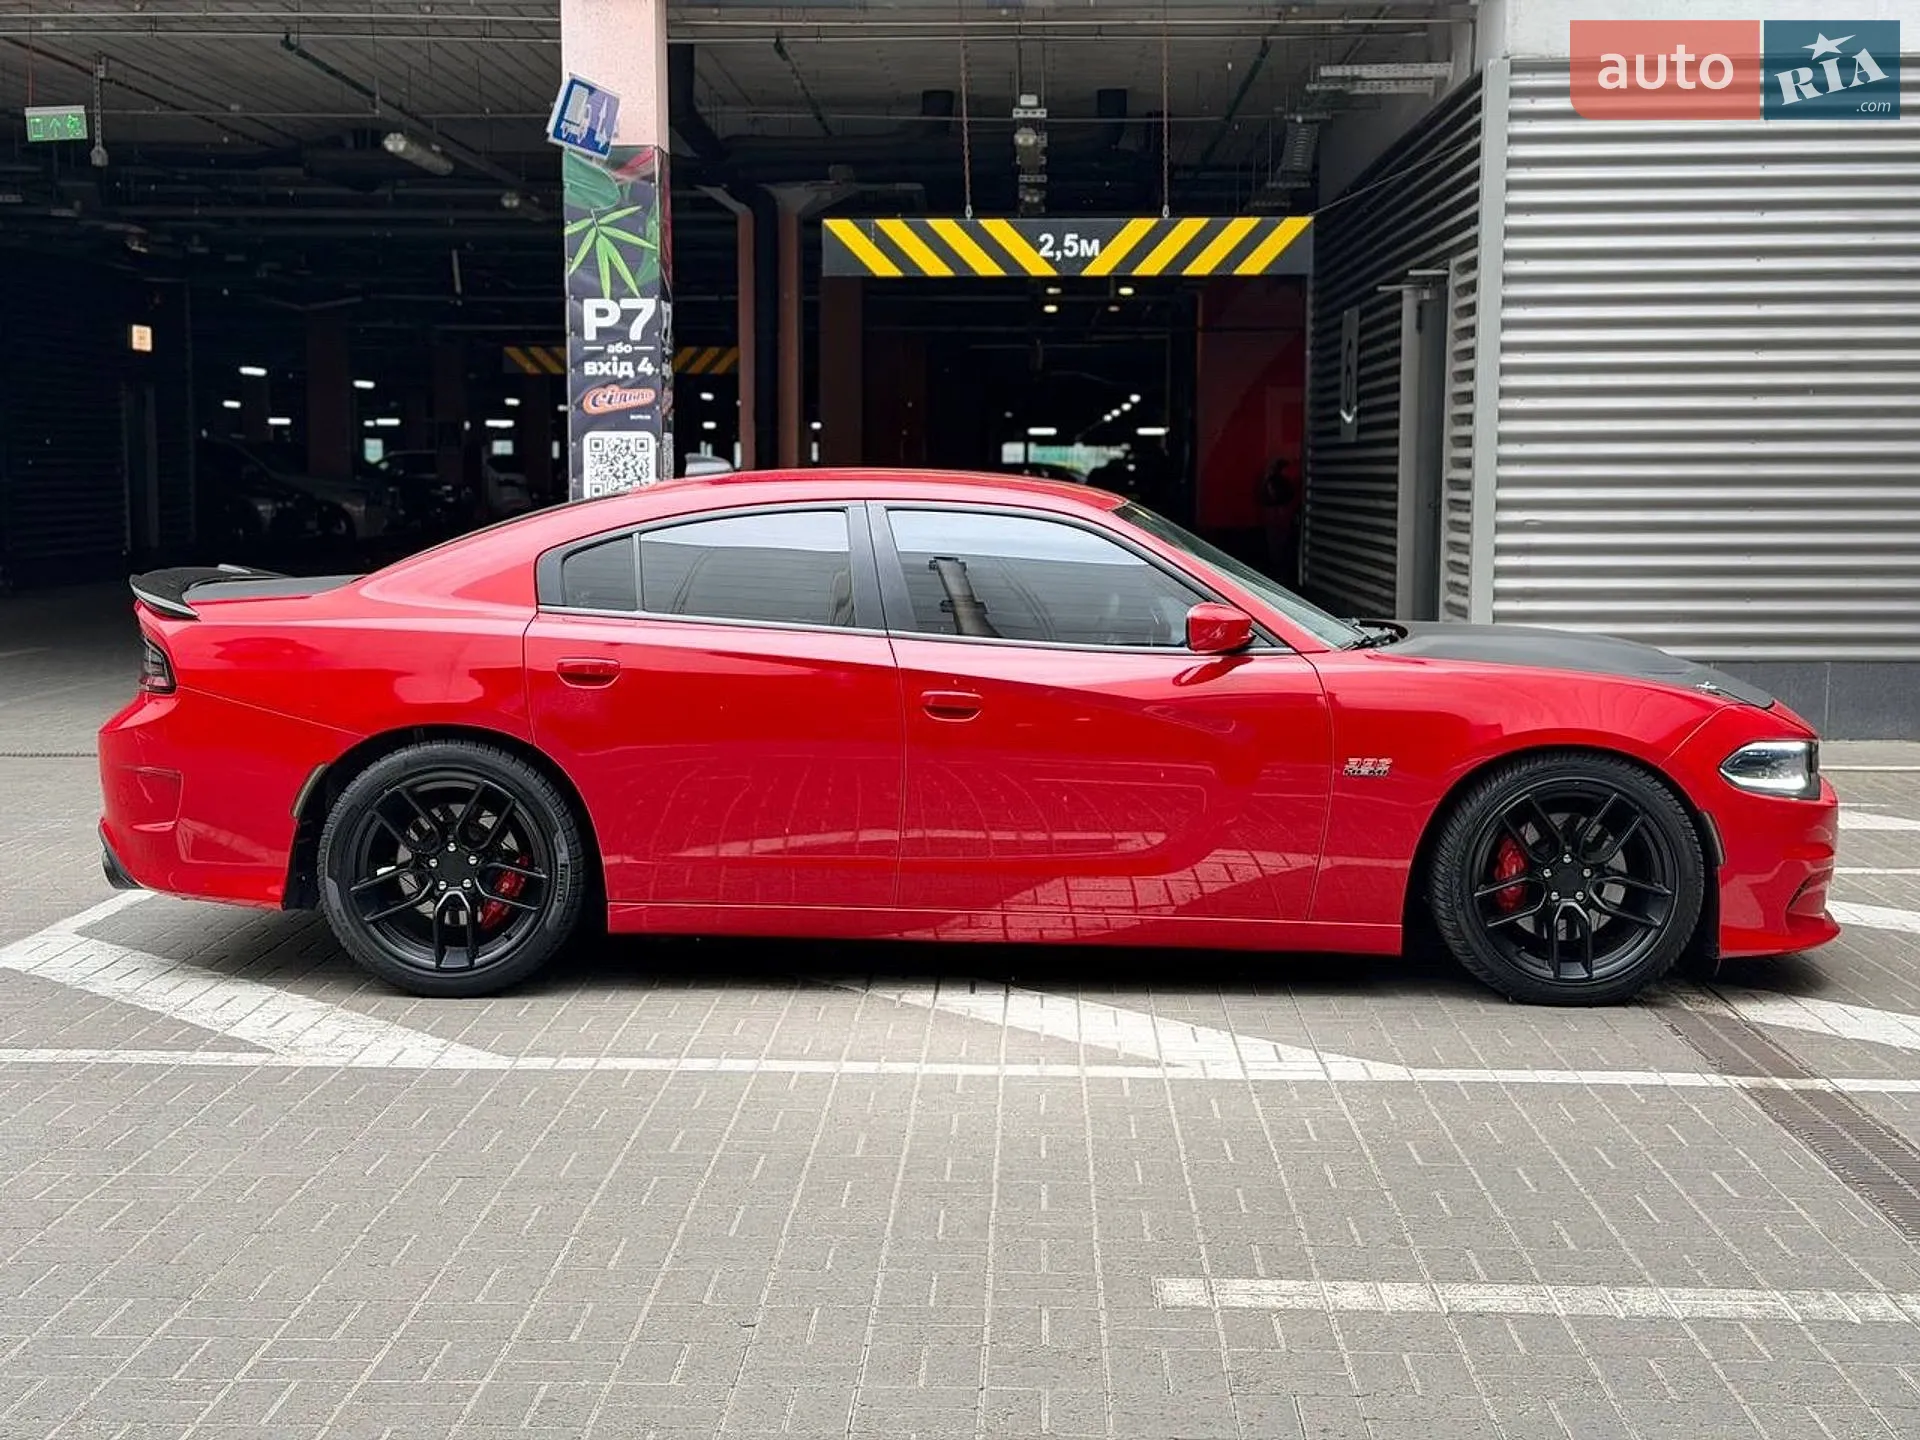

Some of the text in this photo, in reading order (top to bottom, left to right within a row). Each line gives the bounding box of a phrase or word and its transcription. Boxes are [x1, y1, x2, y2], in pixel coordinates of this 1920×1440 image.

[606, 341, 633, 354] або
[583, 355, 656, 379] вхід 4
